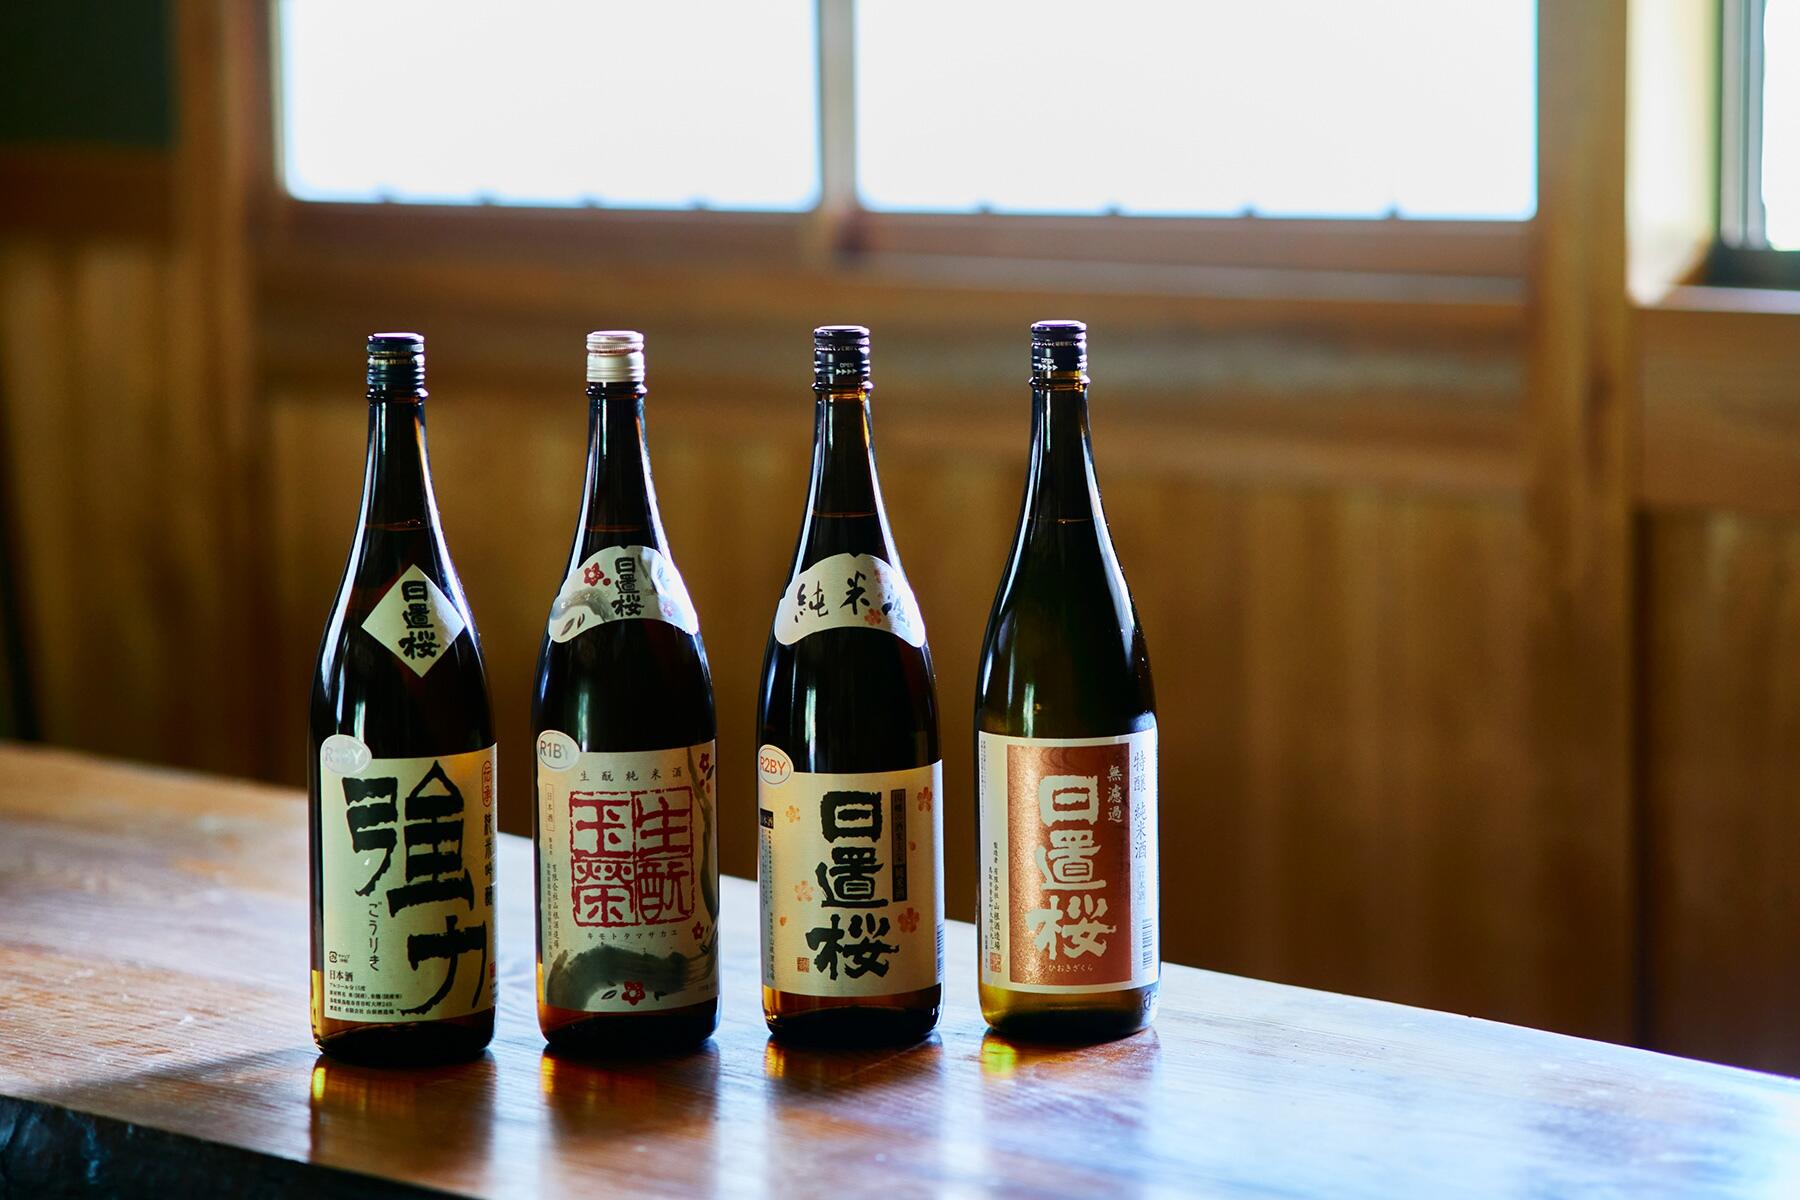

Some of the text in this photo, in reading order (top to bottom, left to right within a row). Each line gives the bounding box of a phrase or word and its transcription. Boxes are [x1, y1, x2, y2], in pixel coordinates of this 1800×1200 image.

[398, 579, 442, 659] 日置桜
[611, 558, 645, 617] 日置桜
[1107, 765, 1123, 823] 無濾過
[805, 791, 900, 980] 日置桜
[1025, 775, 1117, 961] 日置桜
[368, 903, 381, 972] ごうりき
[329, 969, 354, 982] 日本酒
